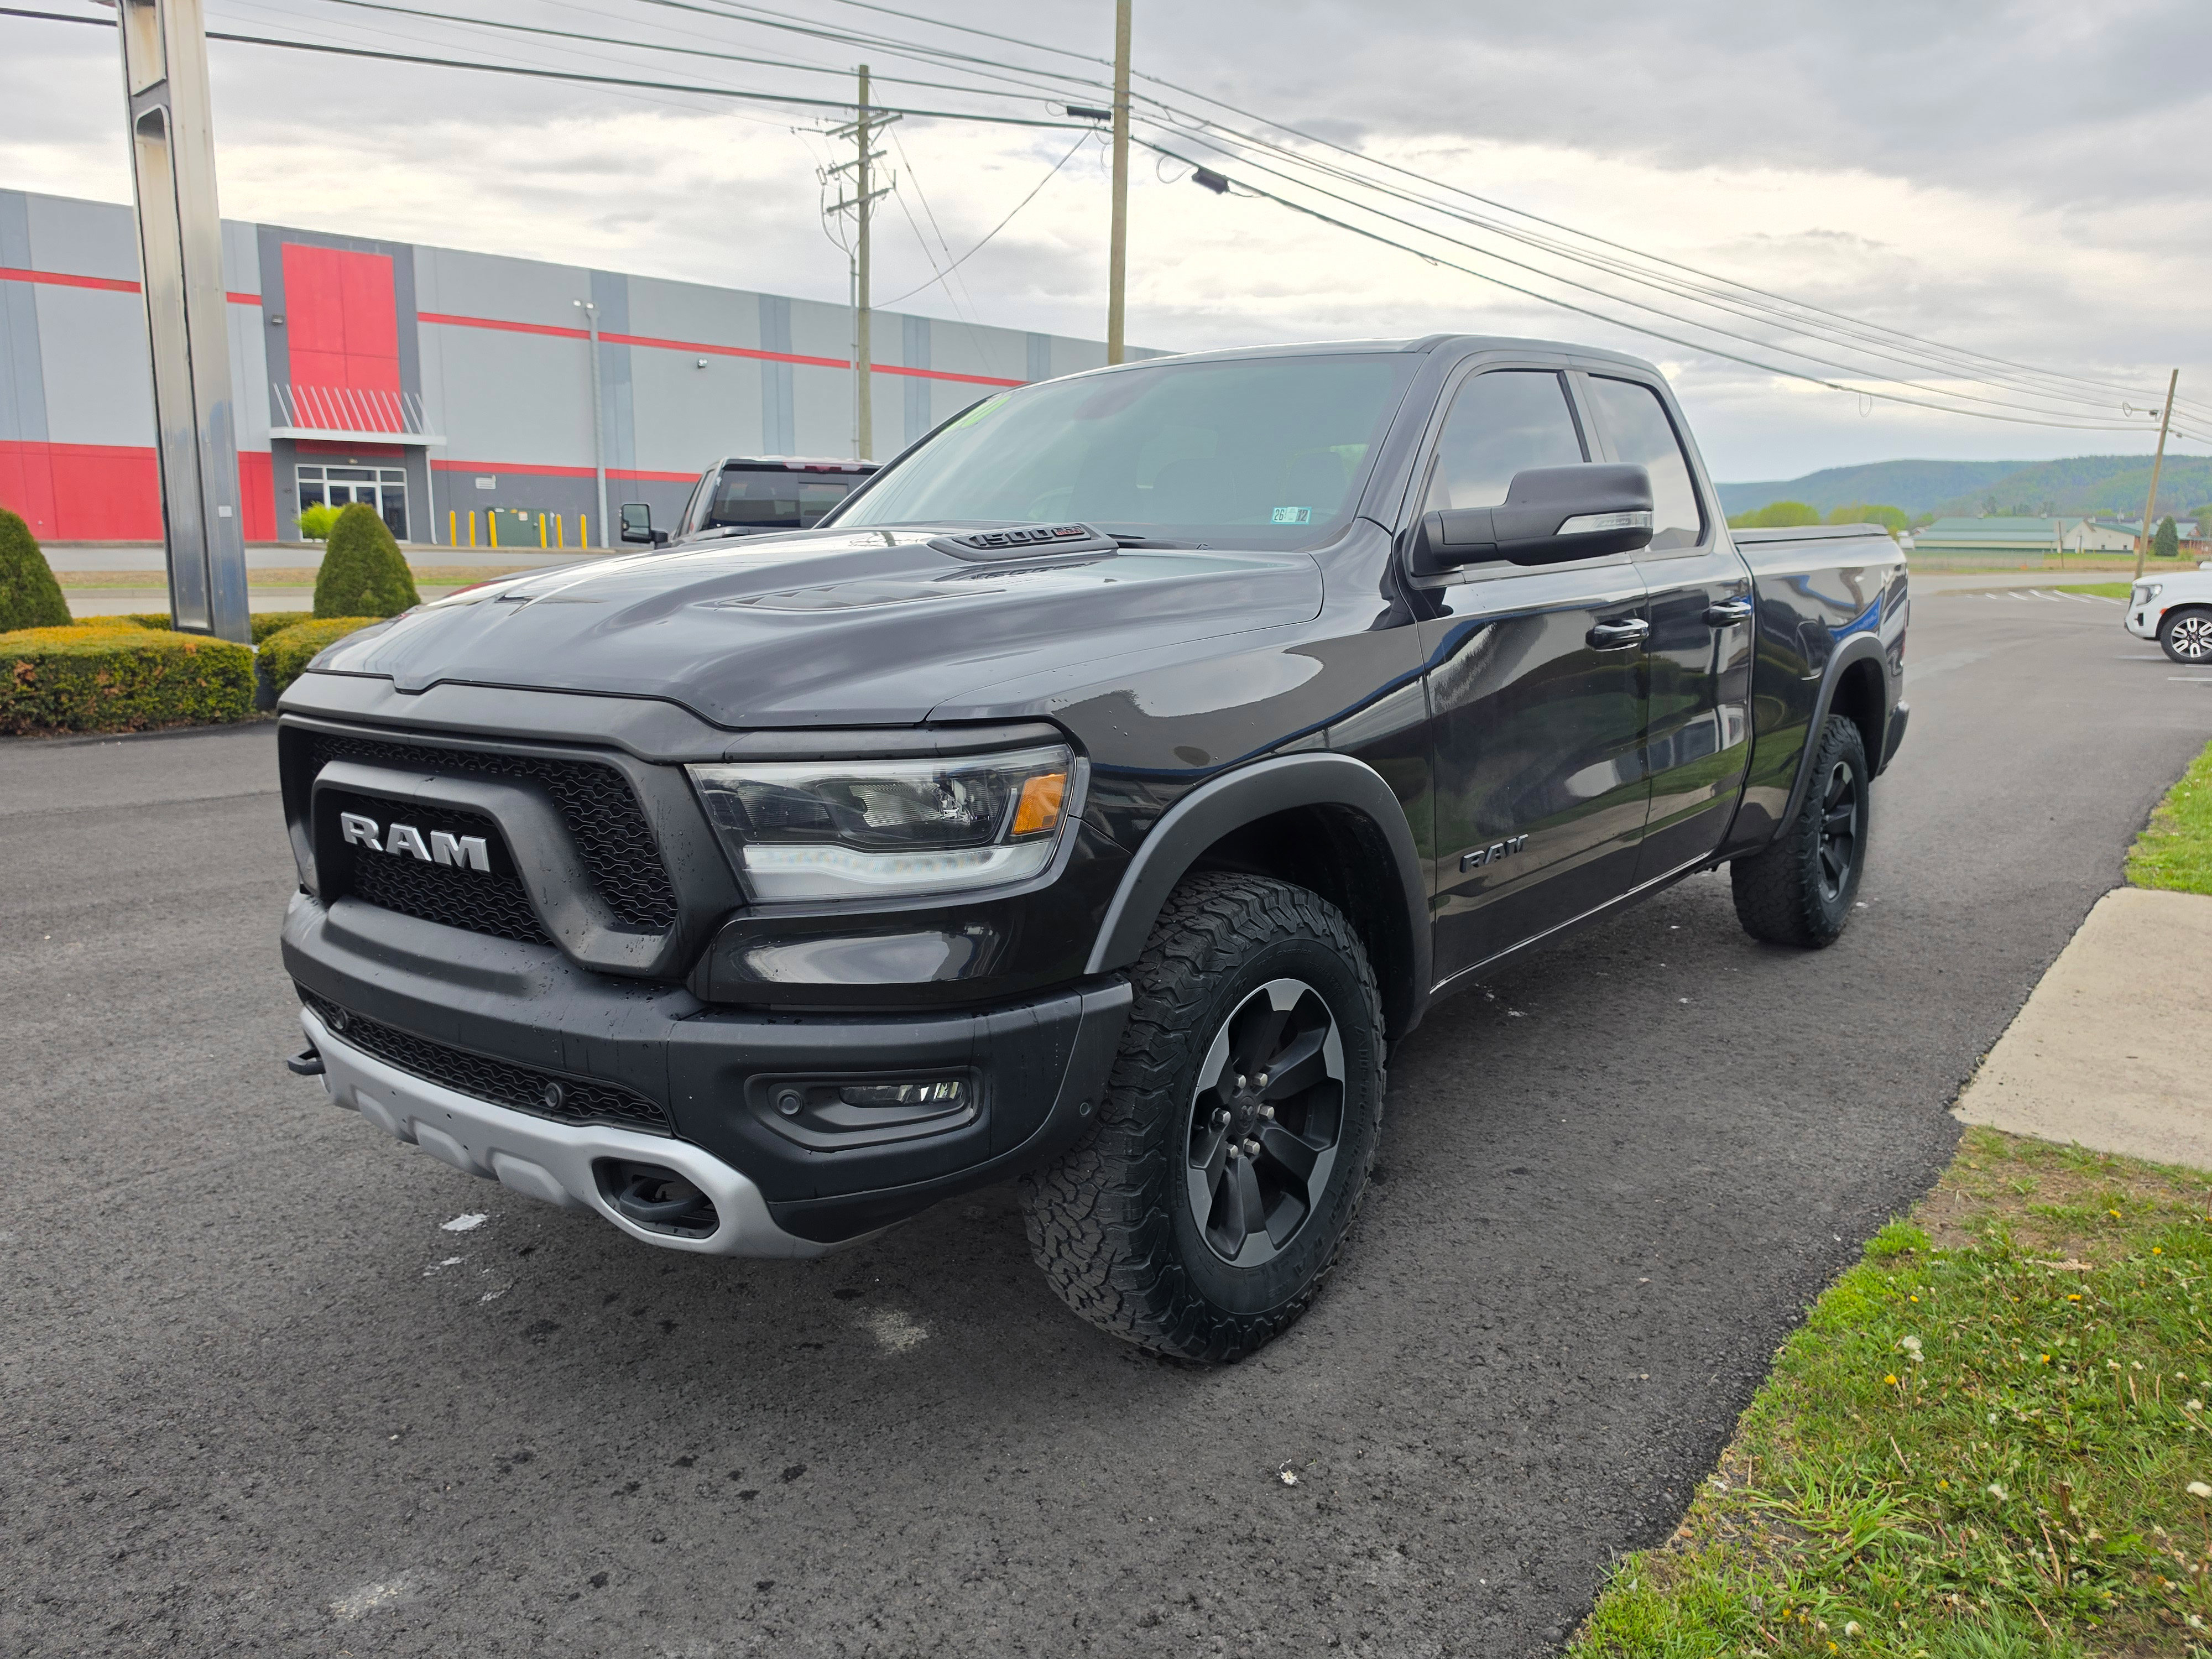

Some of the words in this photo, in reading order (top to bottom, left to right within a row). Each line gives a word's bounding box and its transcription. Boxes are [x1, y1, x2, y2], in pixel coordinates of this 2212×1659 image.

[1274, 509, 1285, 520] 26
[1297, 509, 1308, 521] 12
[969, 529, 1052, 547] 1500
[341, 811, 490, 872] RAM
[1459, 833, 1528, 873] RAM
